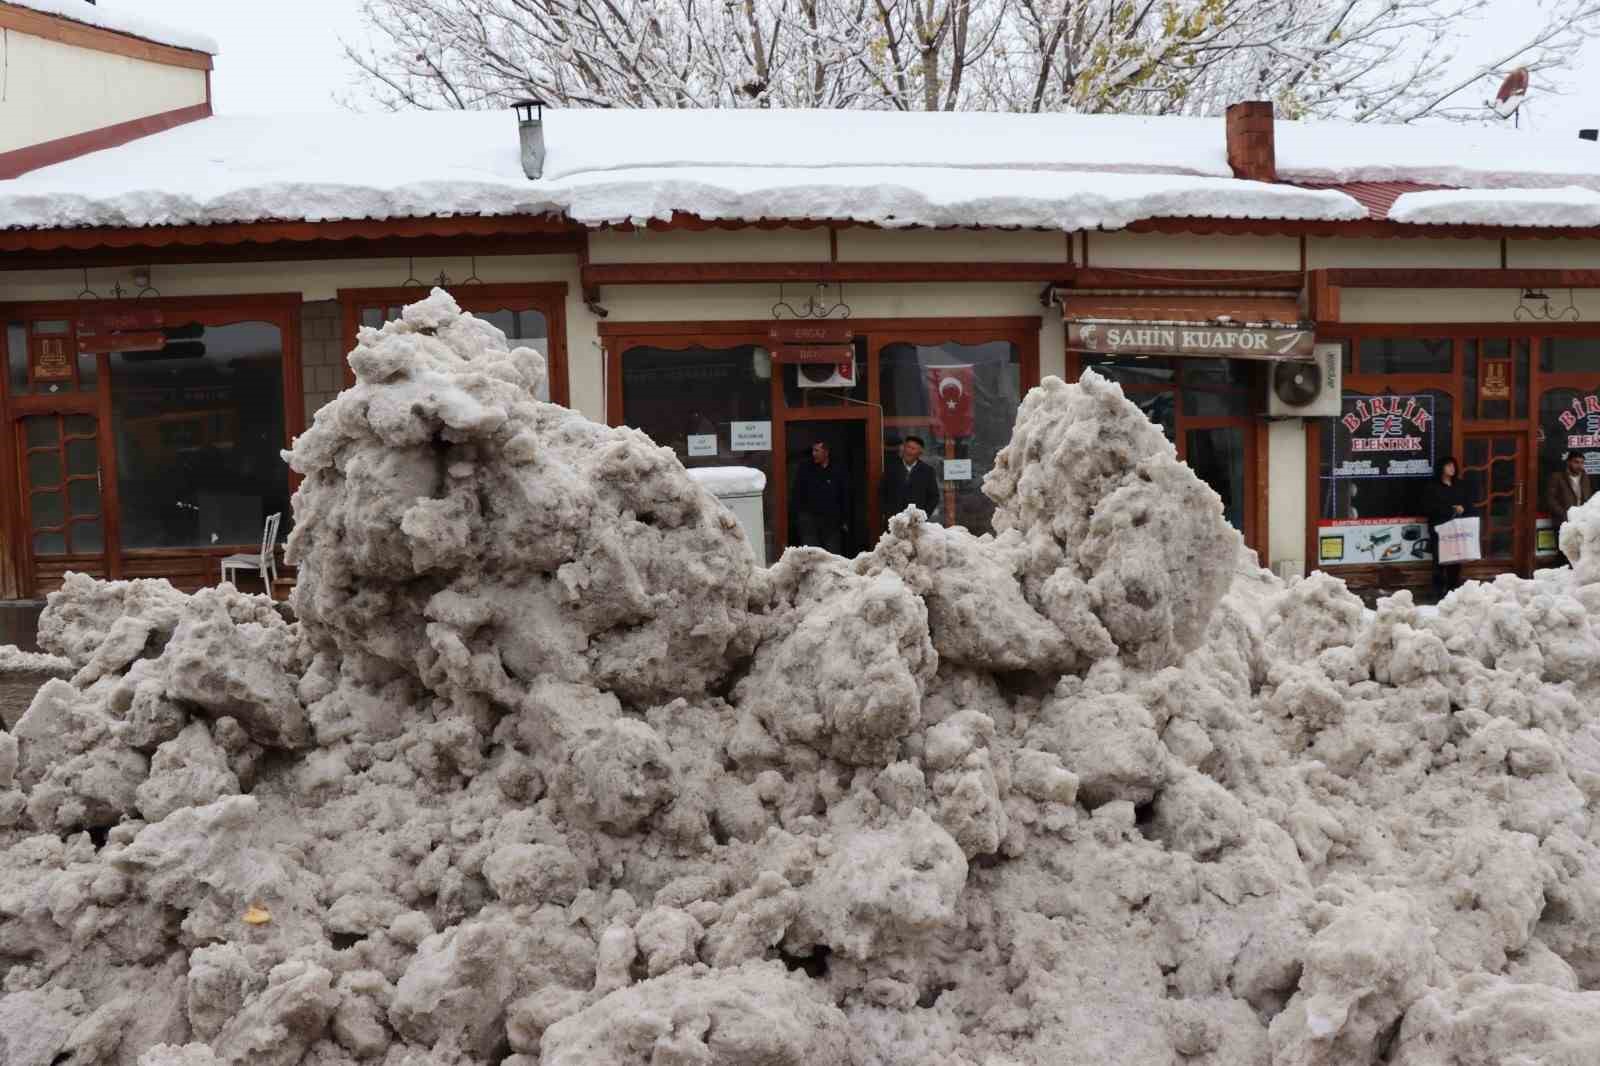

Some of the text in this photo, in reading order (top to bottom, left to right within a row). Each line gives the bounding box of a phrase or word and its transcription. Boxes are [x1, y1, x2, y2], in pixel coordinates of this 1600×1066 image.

[1107, 326, 1268, 350] ŞAHİN KUAFÖR
[1342, 396, 1432, 432] BİRLİK
